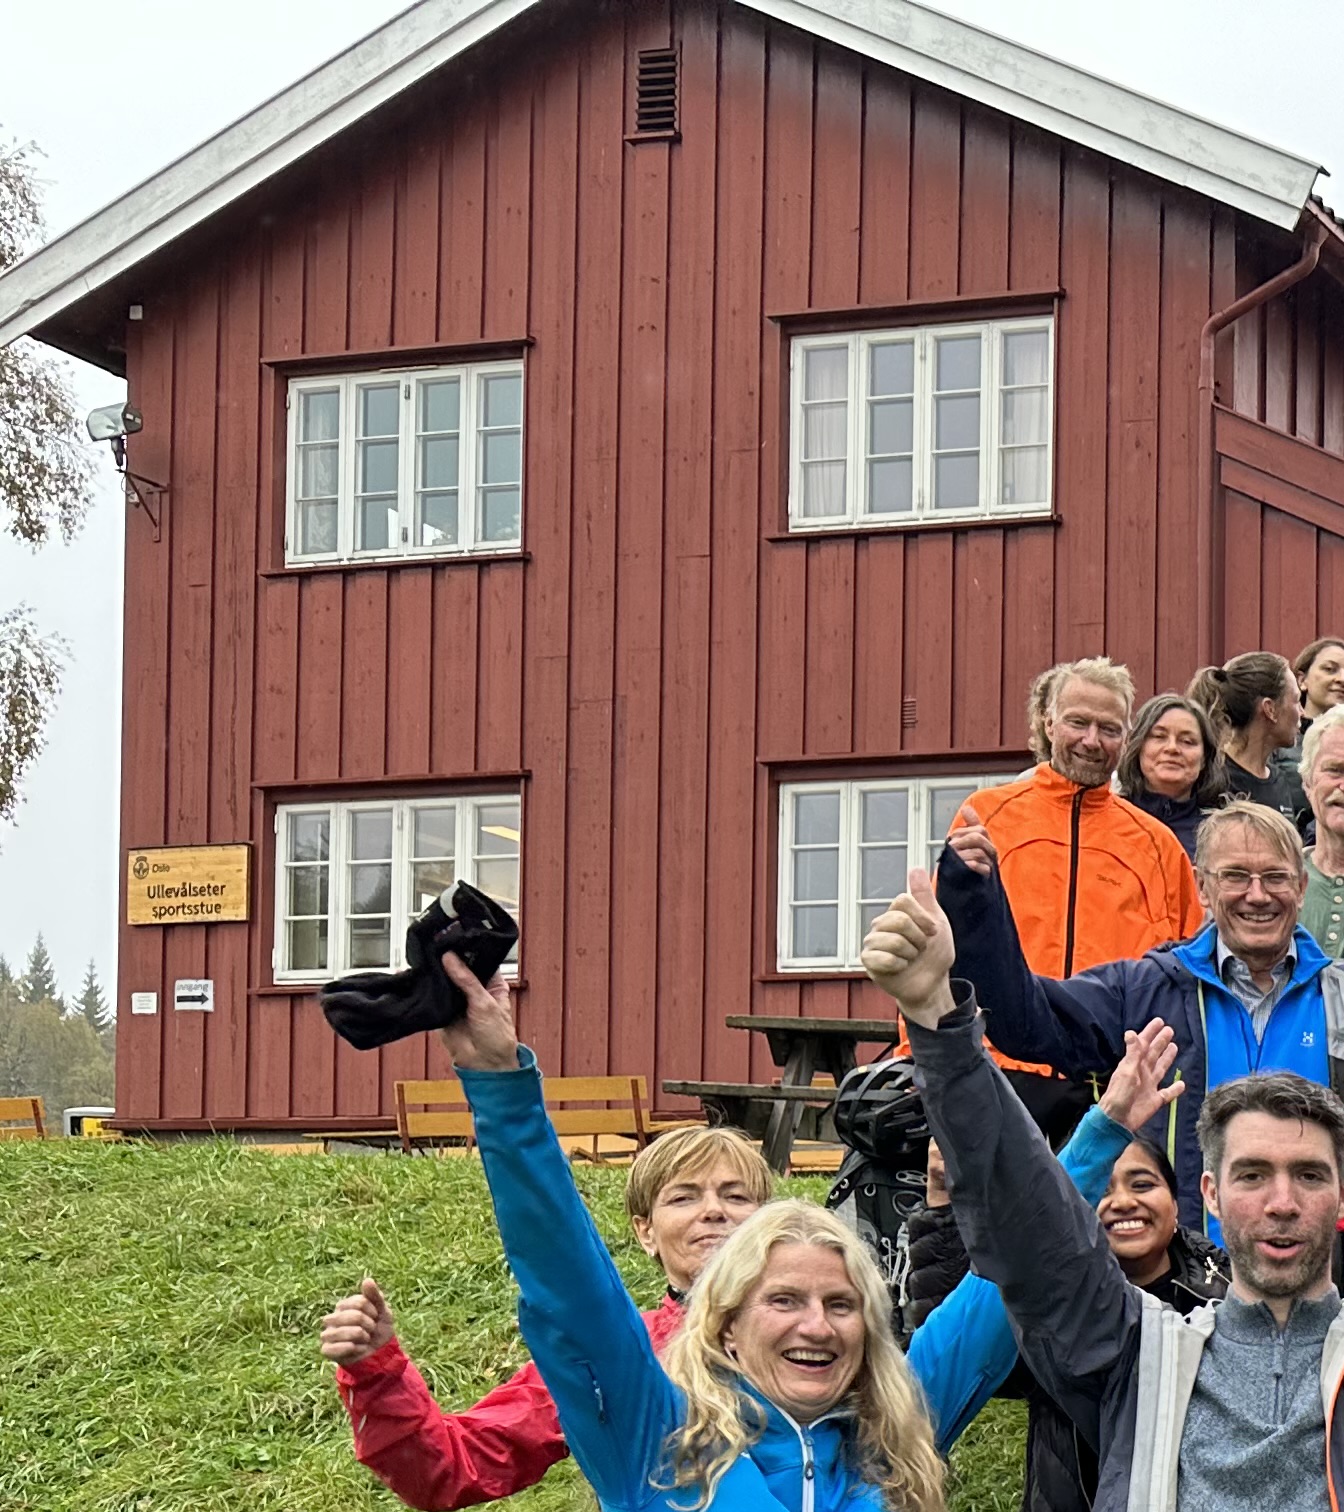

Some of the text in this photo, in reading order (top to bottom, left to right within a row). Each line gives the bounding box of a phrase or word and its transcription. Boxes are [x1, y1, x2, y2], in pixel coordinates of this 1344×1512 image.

[152, 864, 170, 873] Oslo
[147, 882, 226, 899] Ullevålseter
[152, 901, 222, 920] sportsstue
